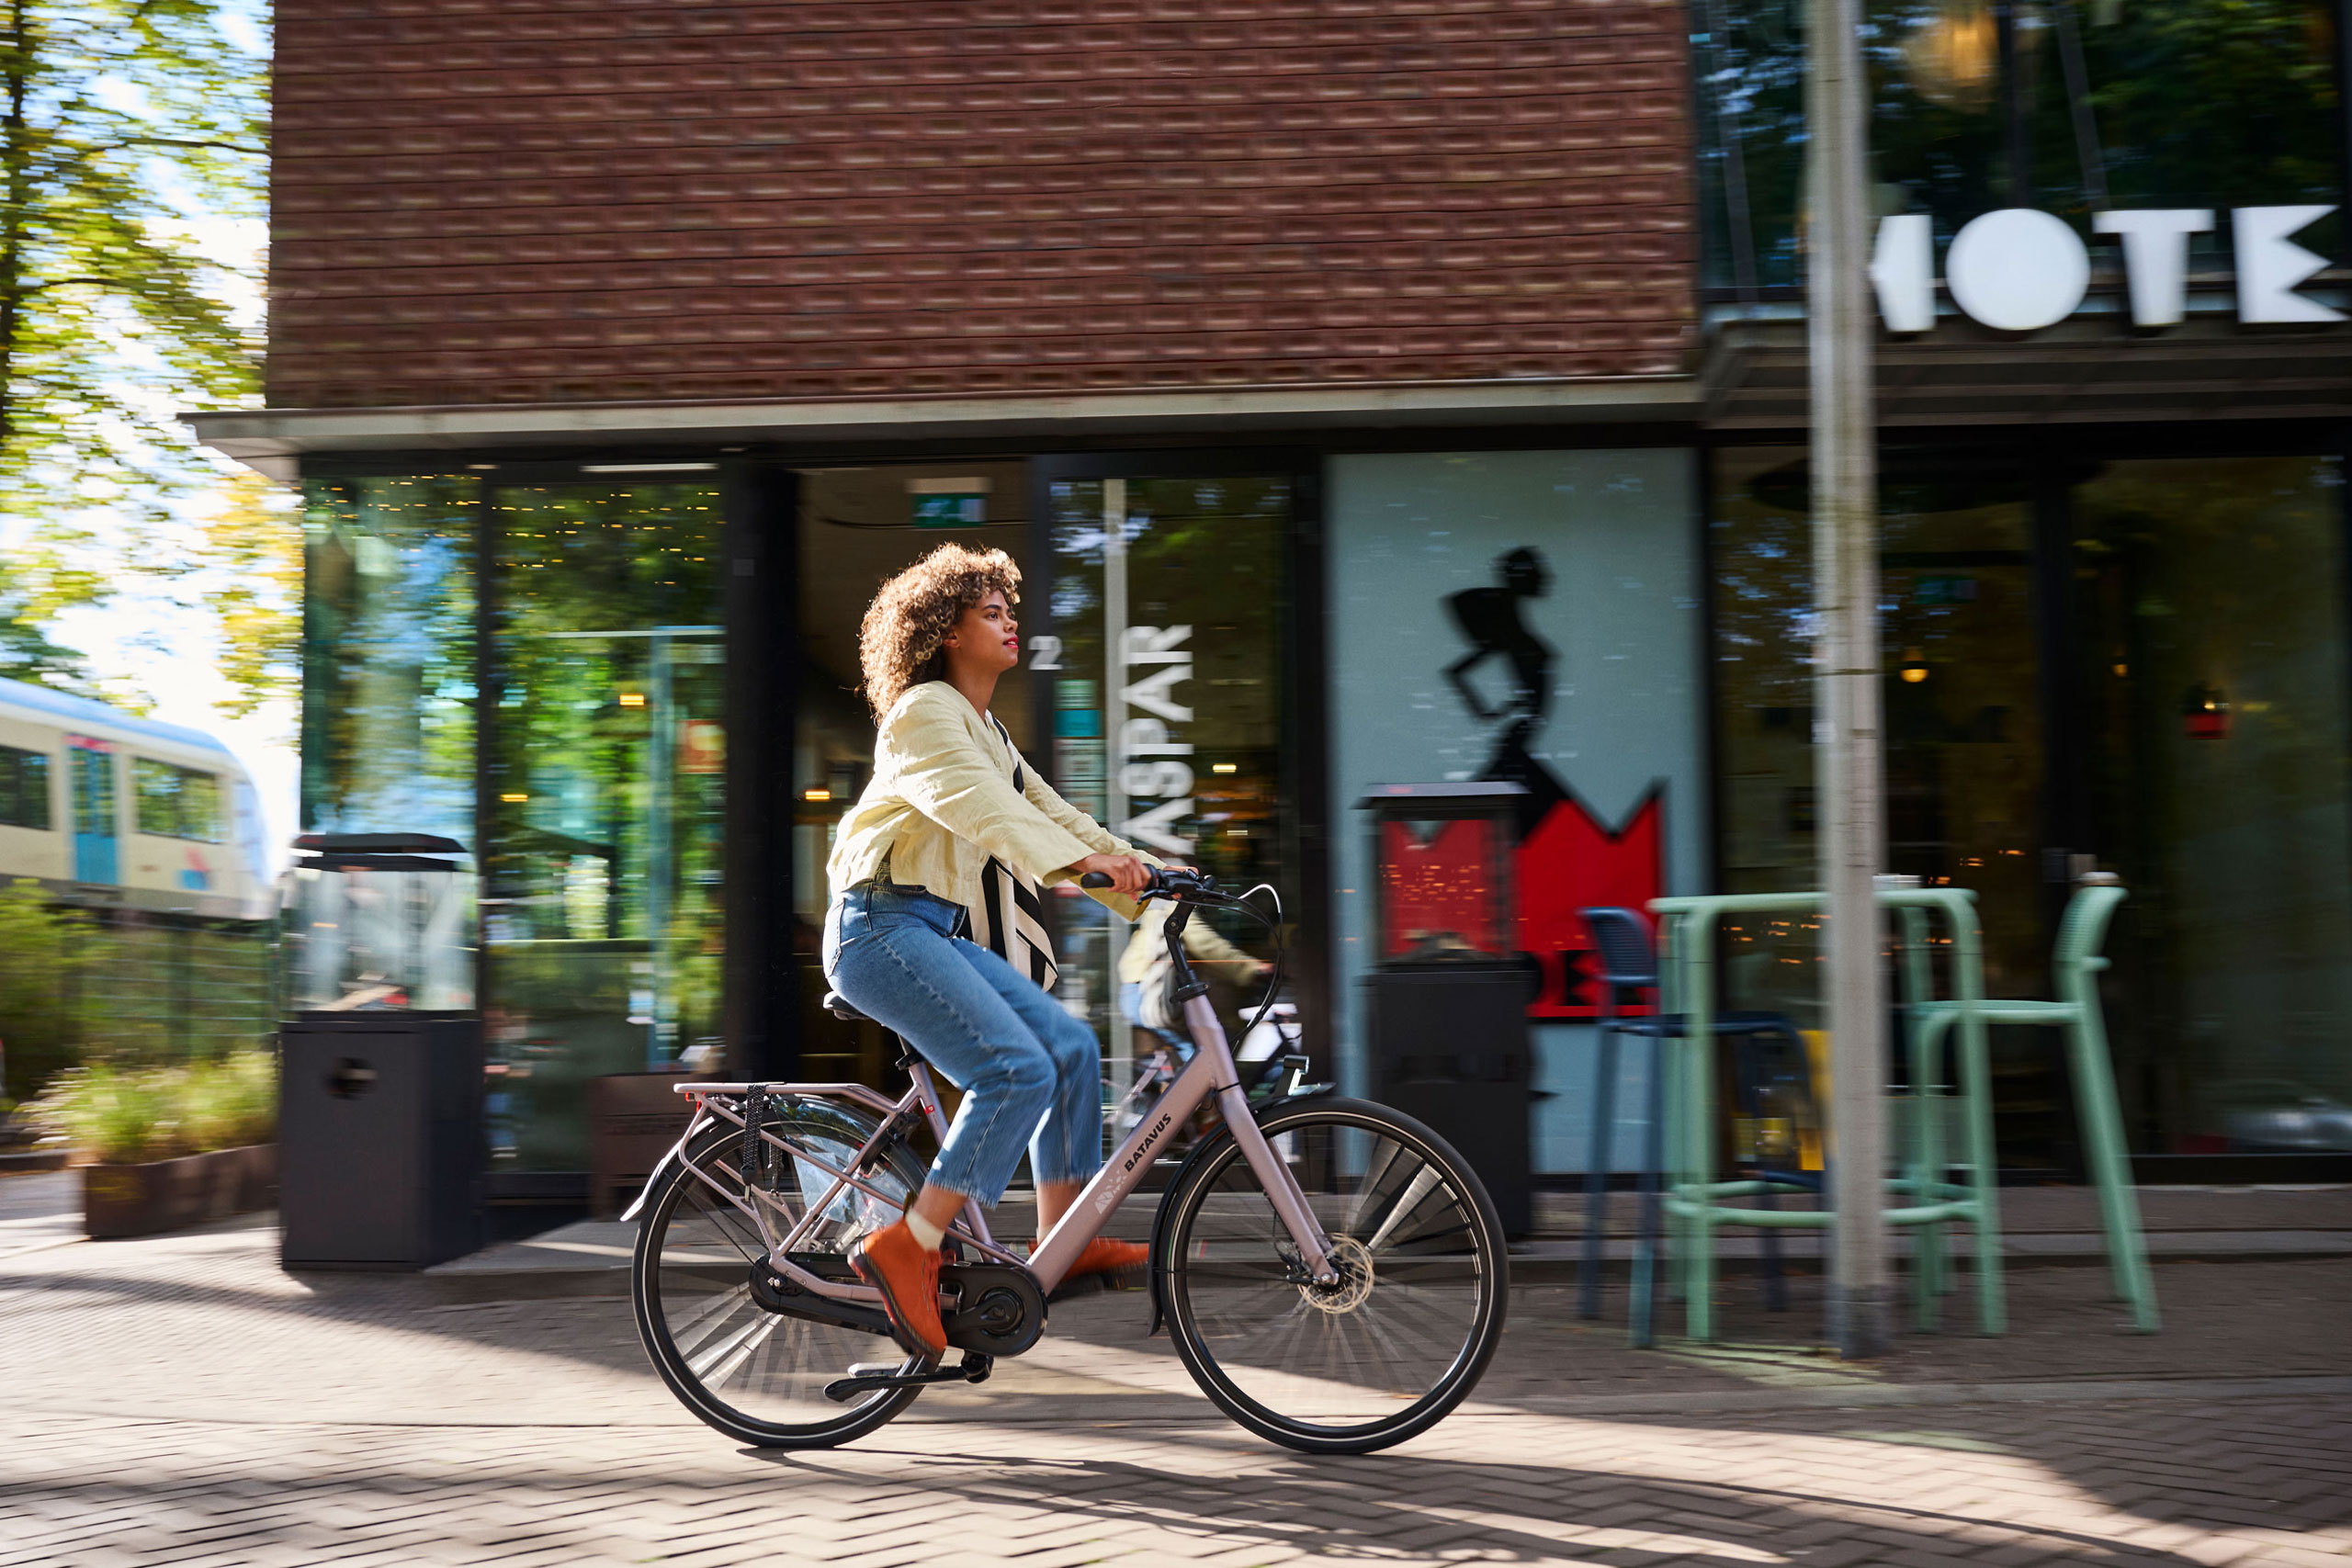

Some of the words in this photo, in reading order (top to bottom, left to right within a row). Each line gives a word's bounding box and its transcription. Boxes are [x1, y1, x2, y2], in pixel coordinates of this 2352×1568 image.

[1028, 635, 1063, 671] 2
[1118, 625, 1193, 866] ASPAR
[1124, 1112, 1172, 1173] BATAVUS
